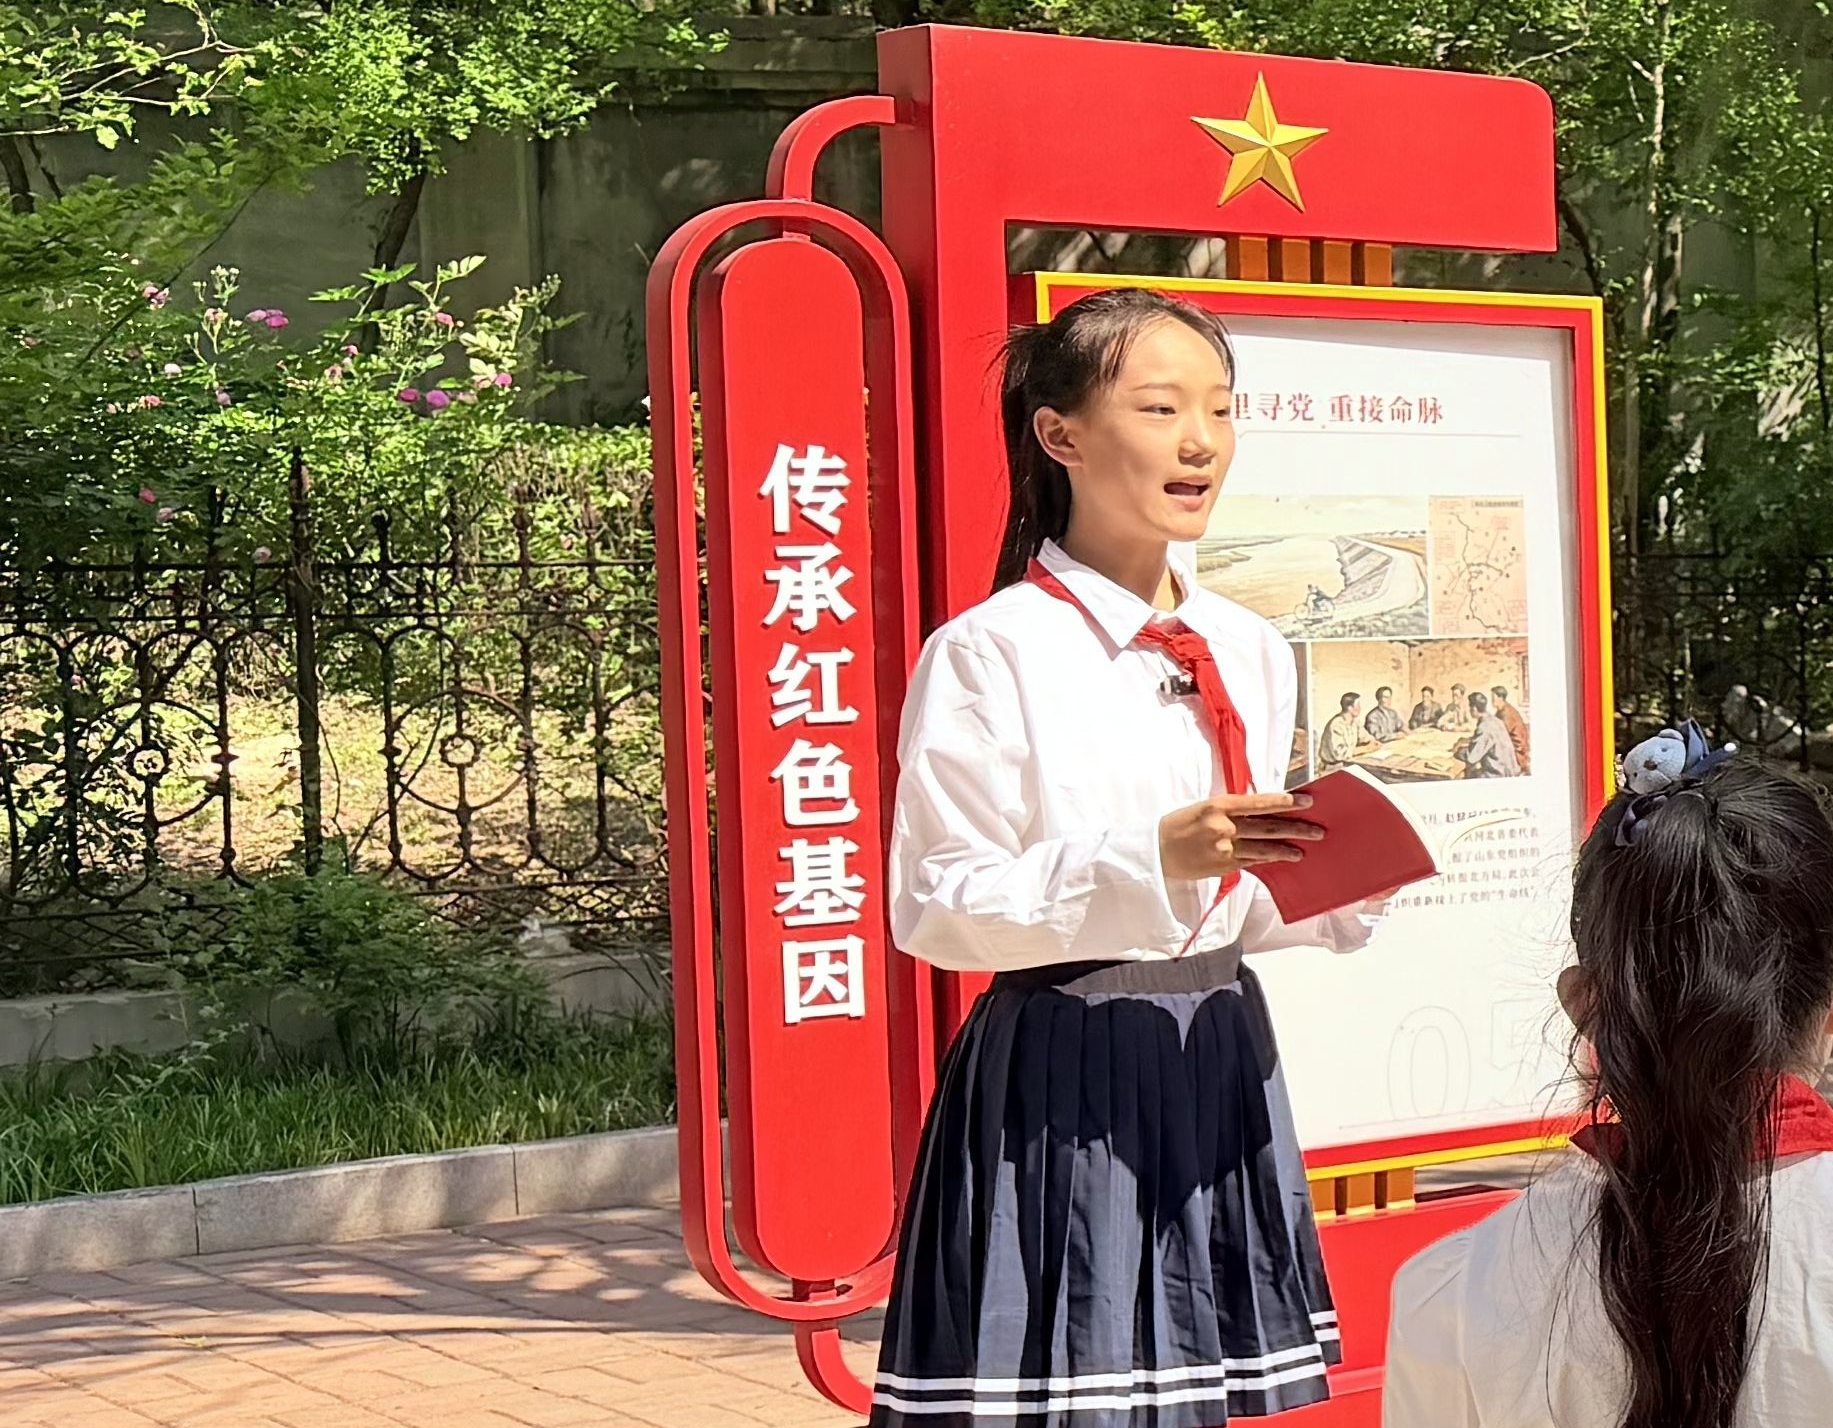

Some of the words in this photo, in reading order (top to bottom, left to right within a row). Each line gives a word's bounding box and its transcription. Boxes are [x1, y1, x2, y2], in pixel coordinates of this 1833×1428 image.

[1329, 394, 1443, 424] 重接命脉
[761, 443, 867, 1025] 传承红色基因
